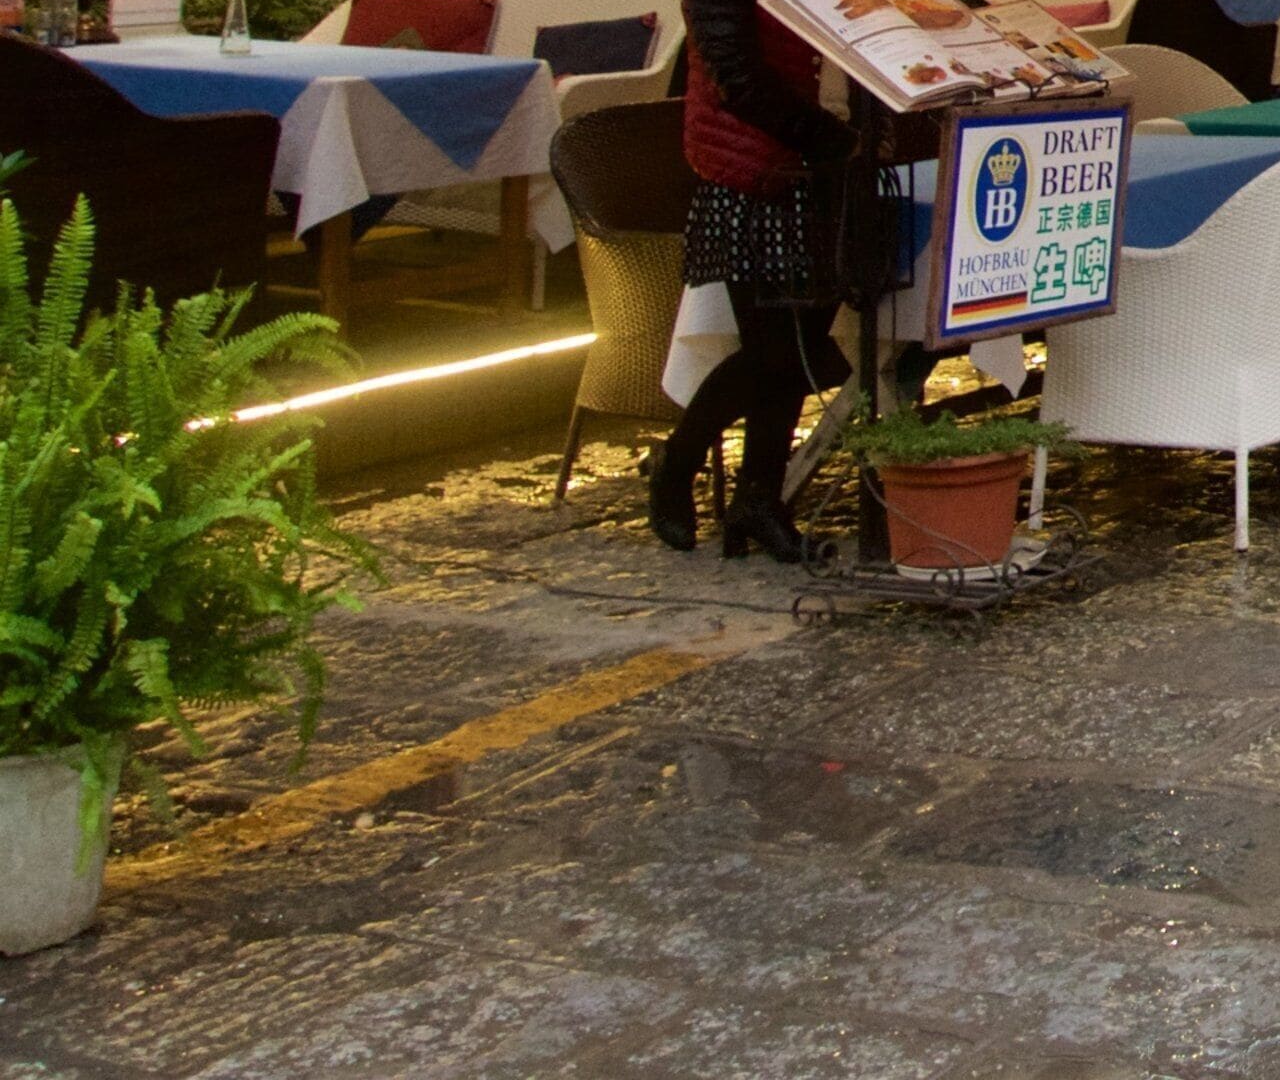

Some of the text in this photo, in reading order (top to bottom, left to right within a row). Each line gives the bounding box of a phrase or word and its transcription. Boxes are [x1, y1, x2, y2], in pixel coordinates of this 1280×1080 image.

[1042, 125, 1119, 157] DRAFT
[1039, 162, 1114, 198] BEER
[983, 186, 1017, 230] HB
[1036, 198, 1112, 235] 正宗德国
[958, 247, 1030, 276] HOFBRÄU
[1030, 235, 1108, 305] 生啤
[956, 272, 1028, 300] MÜNCHEN
